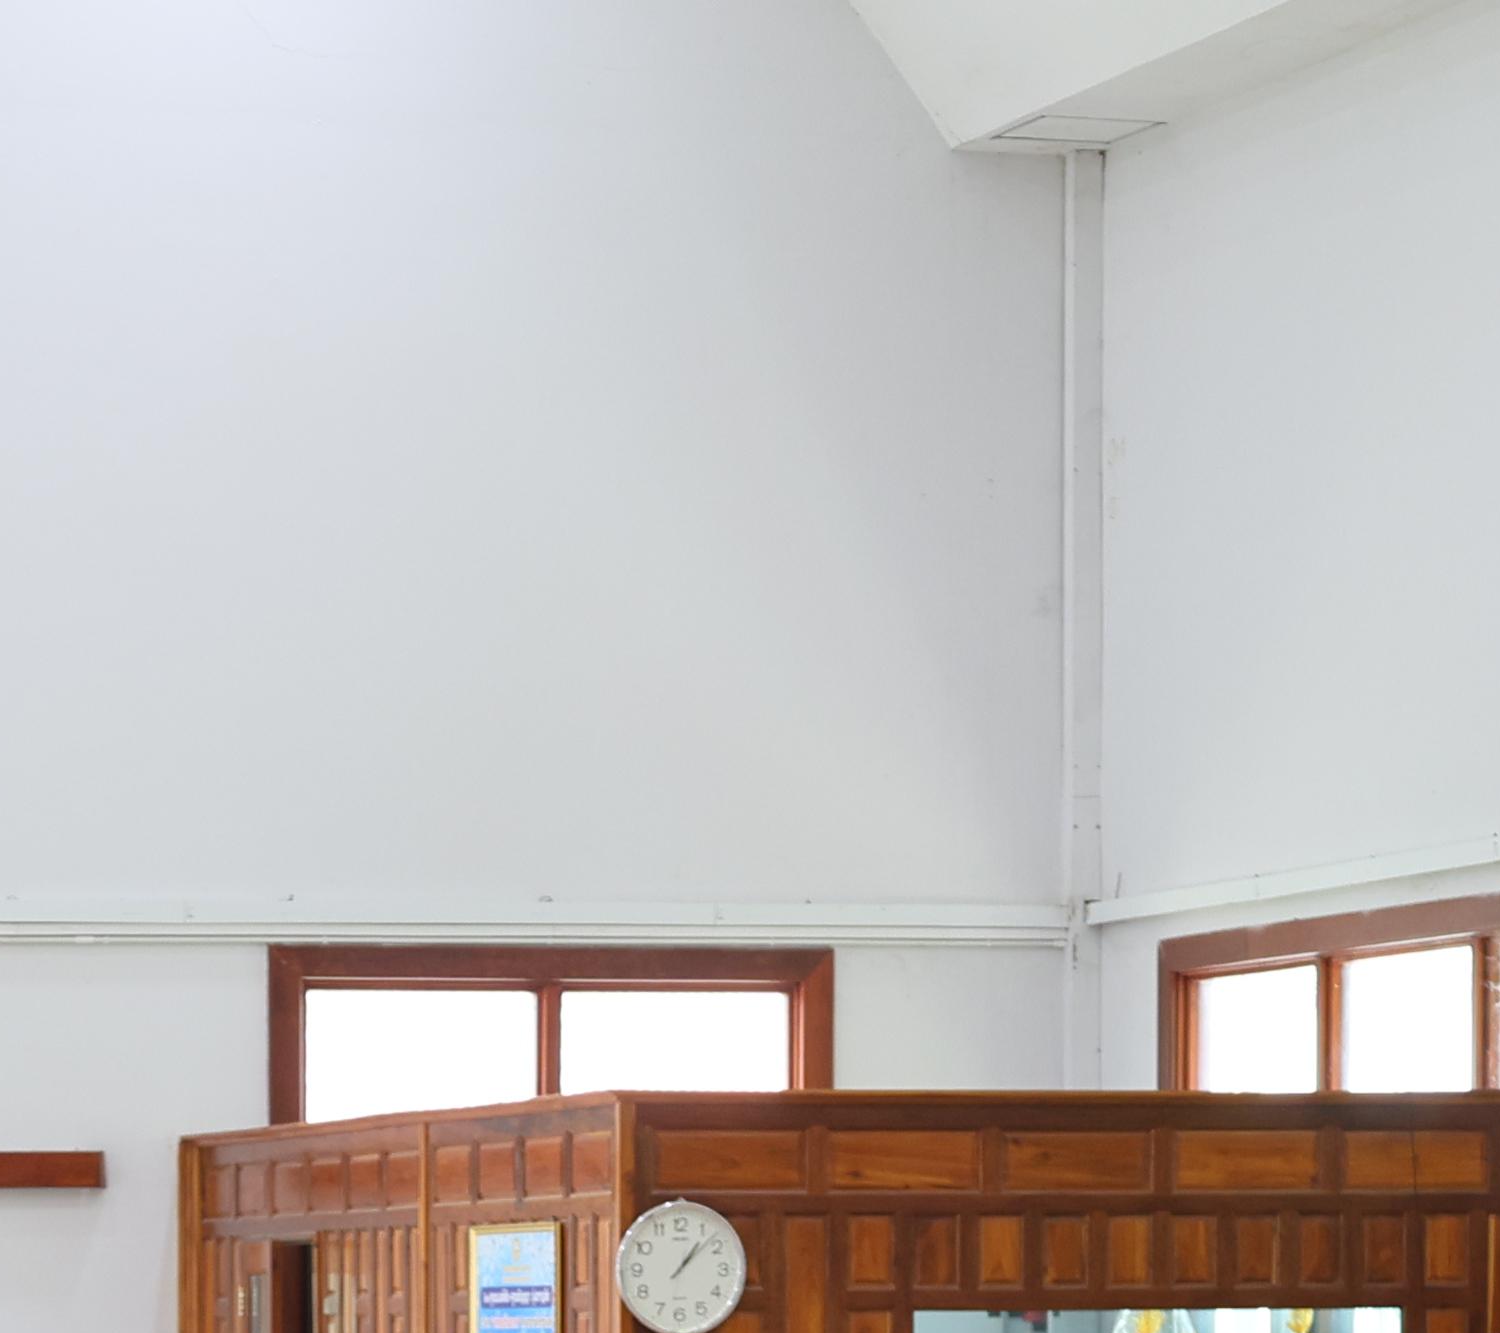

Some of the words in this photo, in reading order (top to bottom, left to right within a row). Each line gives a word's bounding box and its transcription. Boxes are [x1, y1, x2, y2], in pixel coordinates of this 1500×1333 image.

[654, 1222, 665, 1236] 11
[673, 1216, 688, 1232] 12
[699, 1223, 705, 1236] 1
[636, 1240, 652, 1256] 10
[711, 1240, 723, 1254] 2
[631, 1262, 643, 1277] 9
[717, 1262, 729, 1277] 3
[637, 1284, 649, 1299] 8
[710, 1284, 722, 1298] 4
[654, 1302, 666, 1315] 7
[673, 1307, 686, 1322] 6
[695, 1301, 708, 1315] 5
